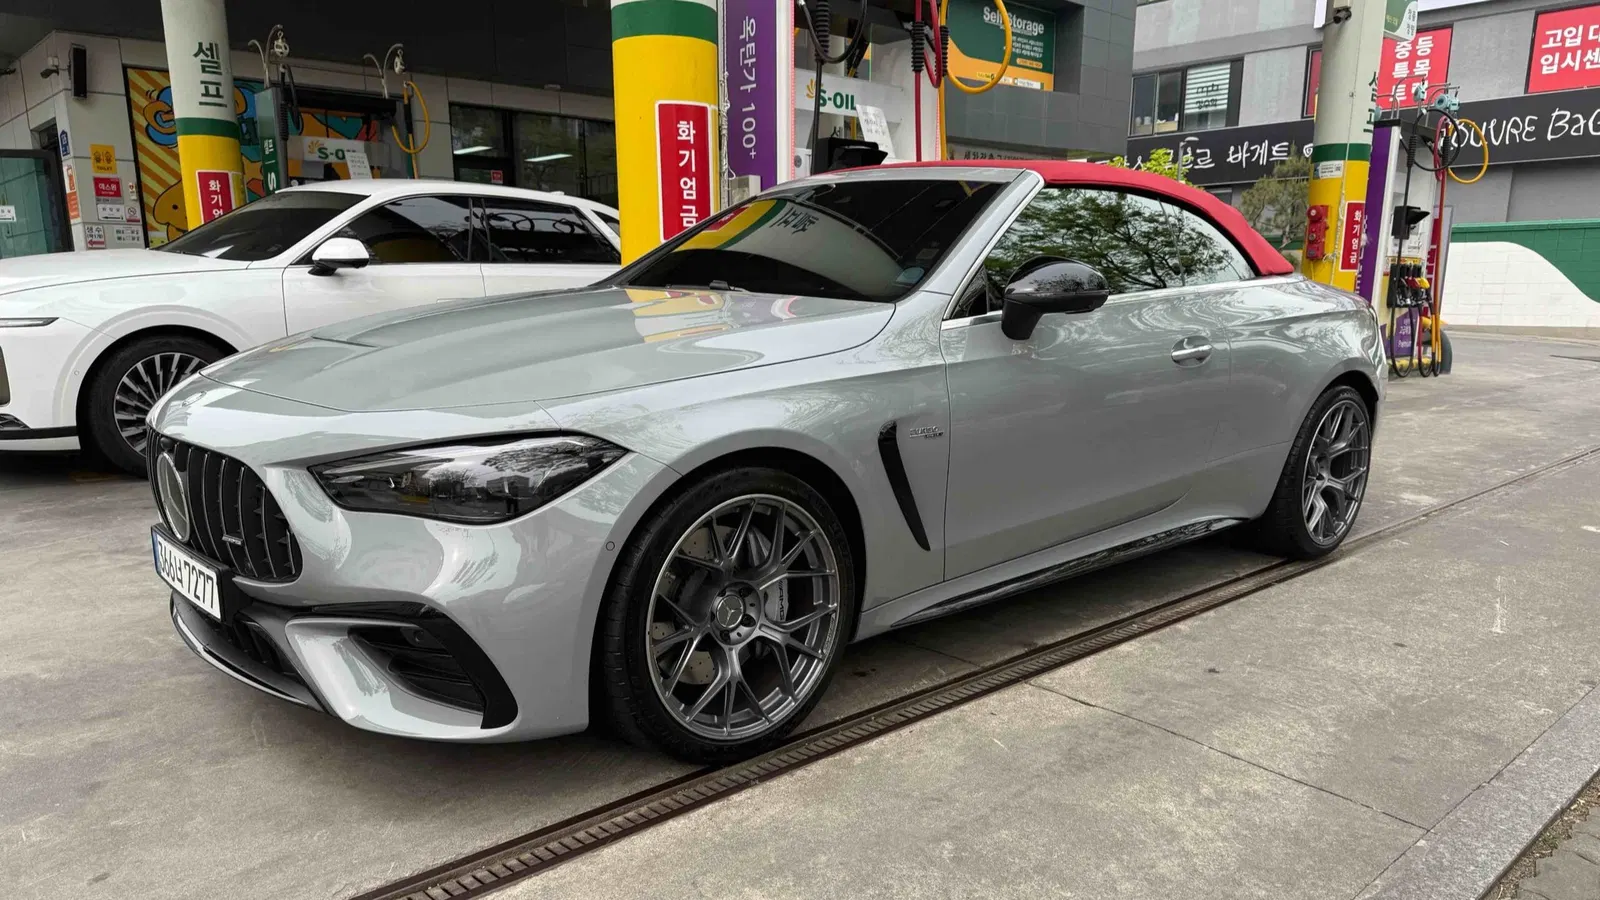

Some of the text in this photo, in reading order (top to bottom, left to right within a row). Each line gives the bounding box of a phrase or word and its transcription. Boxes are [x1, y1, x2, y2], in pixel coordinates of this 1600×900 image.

[1006, 12, 1044, 36] Storage
[1541, 24, 1584, 49] 고입
[193, 41, 228, 108] 셀프
[739, 16, 757, 160] 옥탄가 100+
[819, 88, 858, 111] S-OIL
[677, 120, 700, 228] 화기엄금
[1226, 140, 1290, 169] 바게트
[1349, 210, 1362, 264] 화기엄금
[183, 561, 215, 610] 7277
